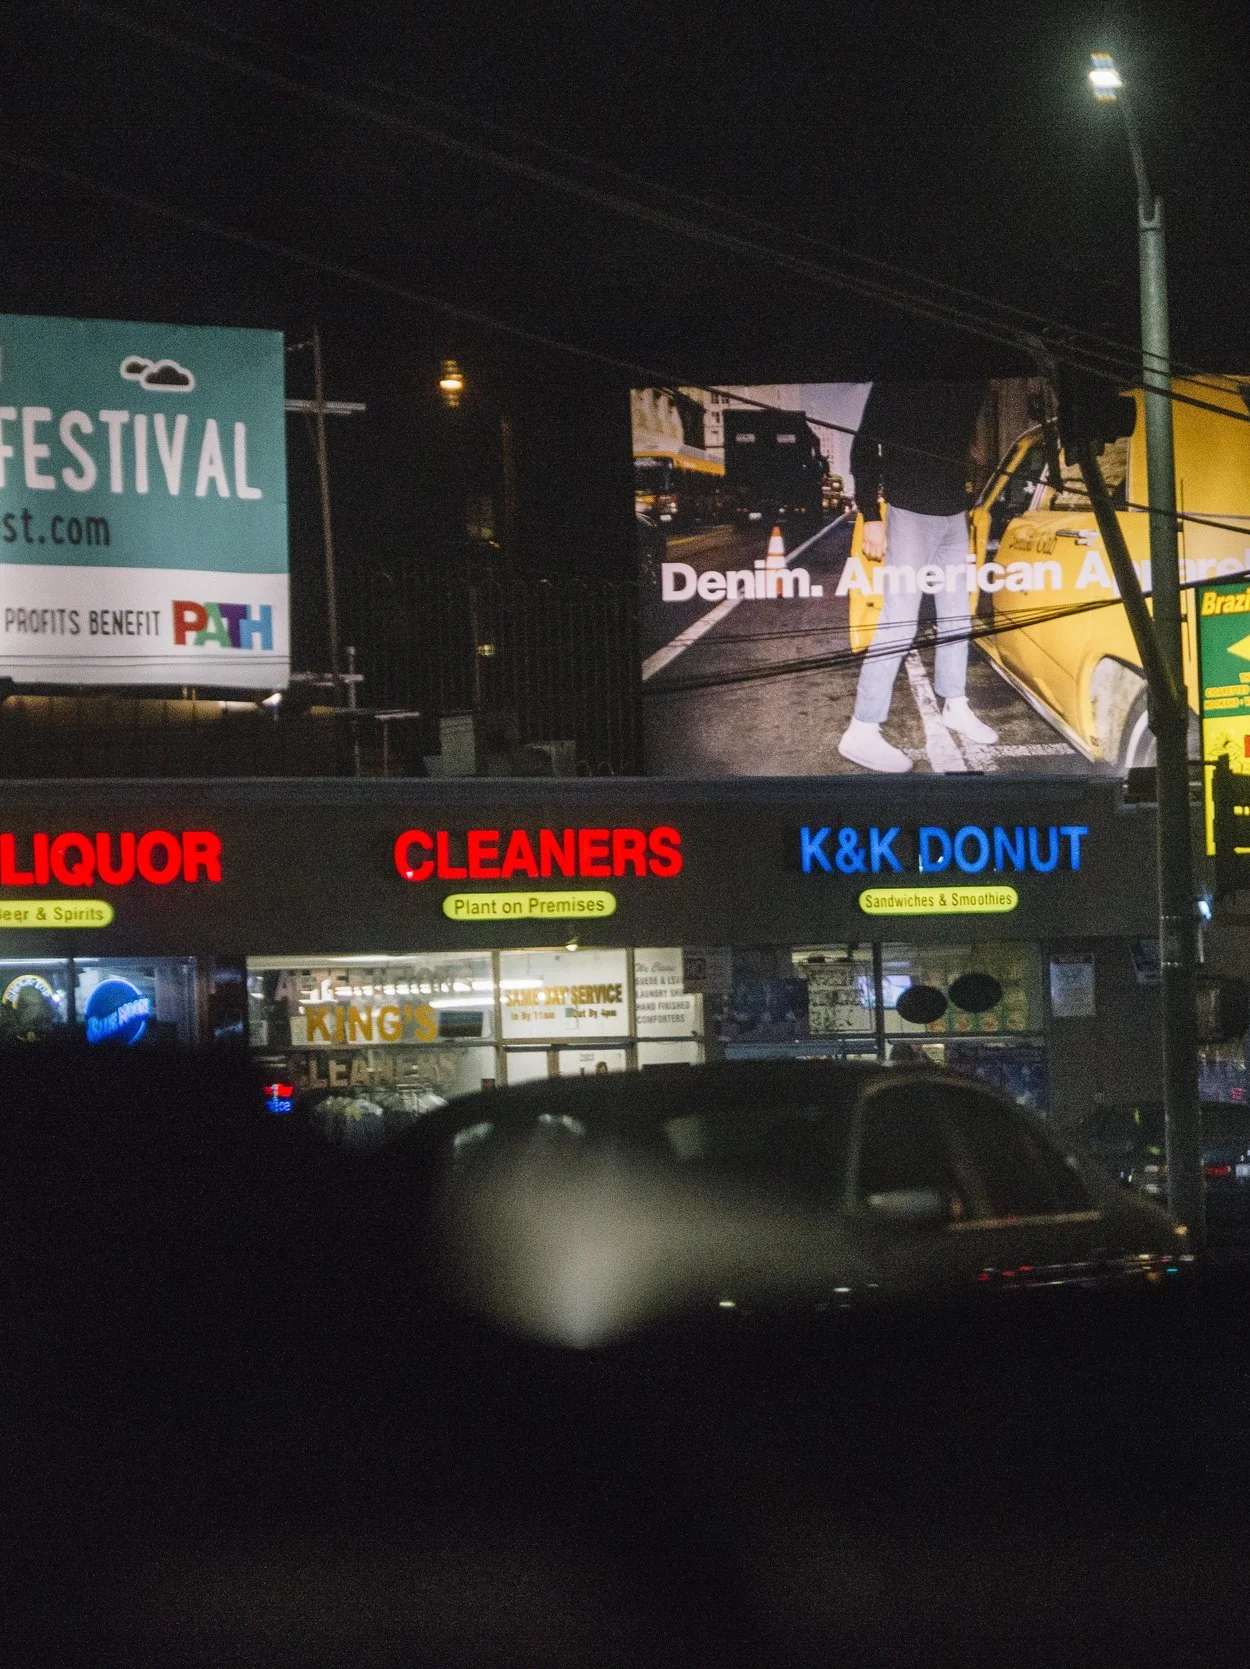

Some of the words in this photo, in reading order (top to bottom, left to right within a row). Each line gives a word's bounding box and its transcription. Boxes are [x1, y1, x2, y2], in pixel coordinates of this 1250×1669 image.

[0, 405, 262, 499] FESTIVAL
[3, 508, 111, 546] st.com
[662, 561, 824, 600] Denim.
[835, 554, 1061, 598] American
[5, 608, 80, 635] PROFITS
[89, 610, 160, 637] BENEFIT
[172, 600, 274, 650] PATH
[0, 830, 223, 887] LIQUOR
[394, 826, 683, 881] CLEANERS
[800, 827, 903, 874] K&K
[919, 825, 1088, 874] DONUT
[0, 908, 29, 921] eer
[36, 907, 47, 920] &
[54, 907, 104, 923] Spirits
[454, 899, 497, 915] Plant
[502, 903, 522, 914] on
[528, 897, 605, 913] Premises
[865, 894, 935, 909] Sandwiches
[939, 894, 947, 906] &
[951, 892, 1012, 906] Smoothies
[571, 982, 622, 1005] SERVICE
[658, 1001, 690, 1010] FINISHED
[306, 1005, 438, 1042] KING'S
